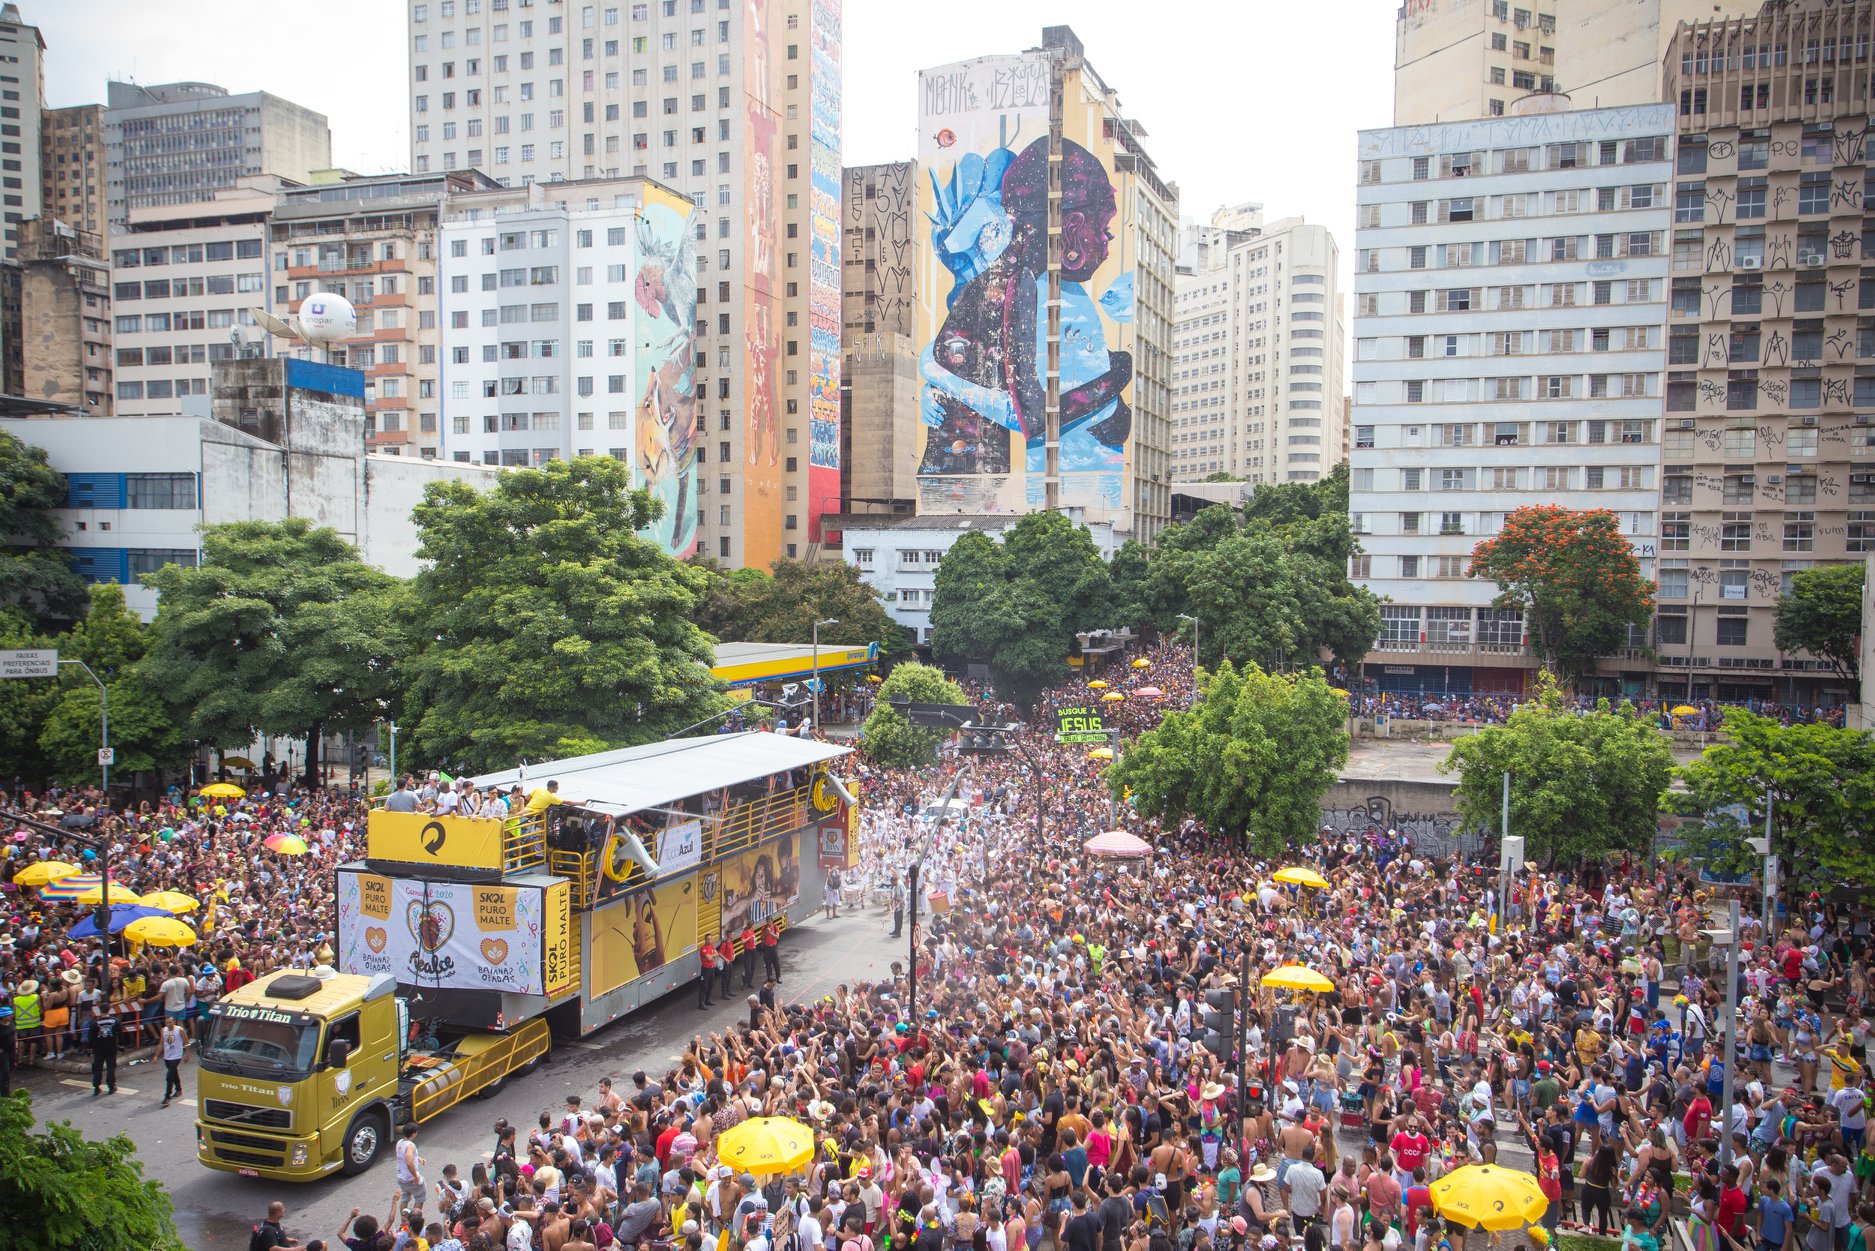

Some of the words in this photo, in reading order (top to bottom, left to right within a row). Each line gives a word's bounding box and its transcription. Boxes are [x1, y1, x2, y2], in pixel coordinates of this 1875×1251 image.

[306, 317, 334, 325] unopar
[1057, 706, 1088, 716] BUSQUE
[1057, 717, 1102, 734] JESUS
[365, 881, 385, 893] SKOL
[365, 893, 386, 903] PURO
[435, 890, 454, 899] 2020
[480, 892, 505, 904] SKOL
[365, 904, 389, 914] MALTE
[480, 905, 507, 914] PURO
[480, 915, 511, 925] MALTE
[548, 944, 557, 983] SKOL
[226, 1005, 250, 1018] Trio
[257, 1009, 292, 1024] Titan
[220, 1082, 239, 1090] Trio
[240, 1083, 275, 1096] Titan
